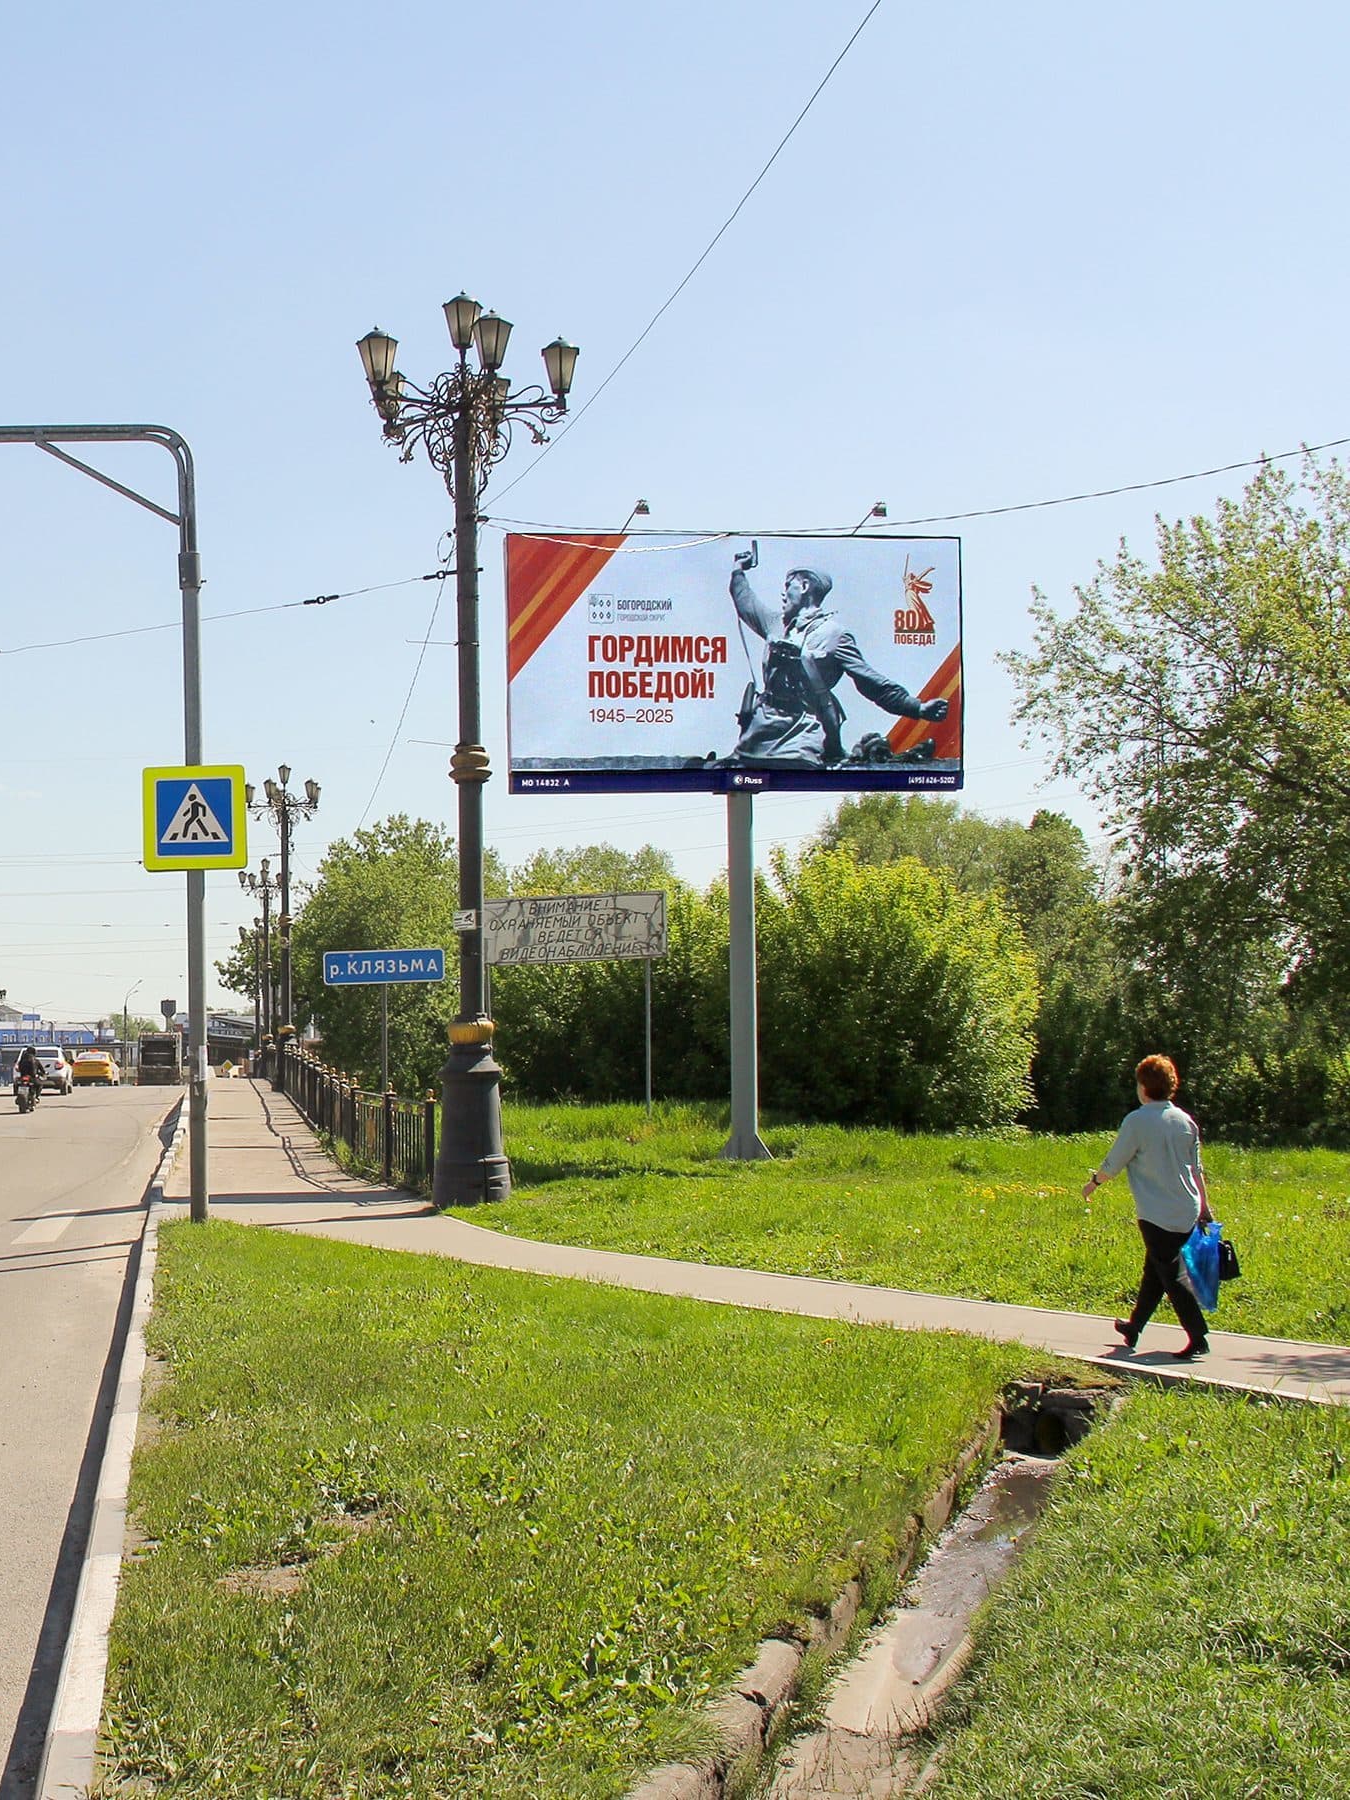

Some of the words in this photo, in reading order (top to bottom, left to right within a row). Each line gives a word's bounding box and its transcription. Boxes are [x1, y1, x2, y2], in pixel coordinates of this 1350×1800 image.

[617, 598, 672, 611] БОГОРОДСКИЙ
[894, 634, 936, 646] ПОБЕДА!
[588, 635, 727, 667] ГОРДИМСЯ
[588, 668, 715, 703] ПОБЕДОЙ!
[744, 776, 763, 784] Russ
[489, 914, 581, 932] ОХРАНЯЕМЫЙ
